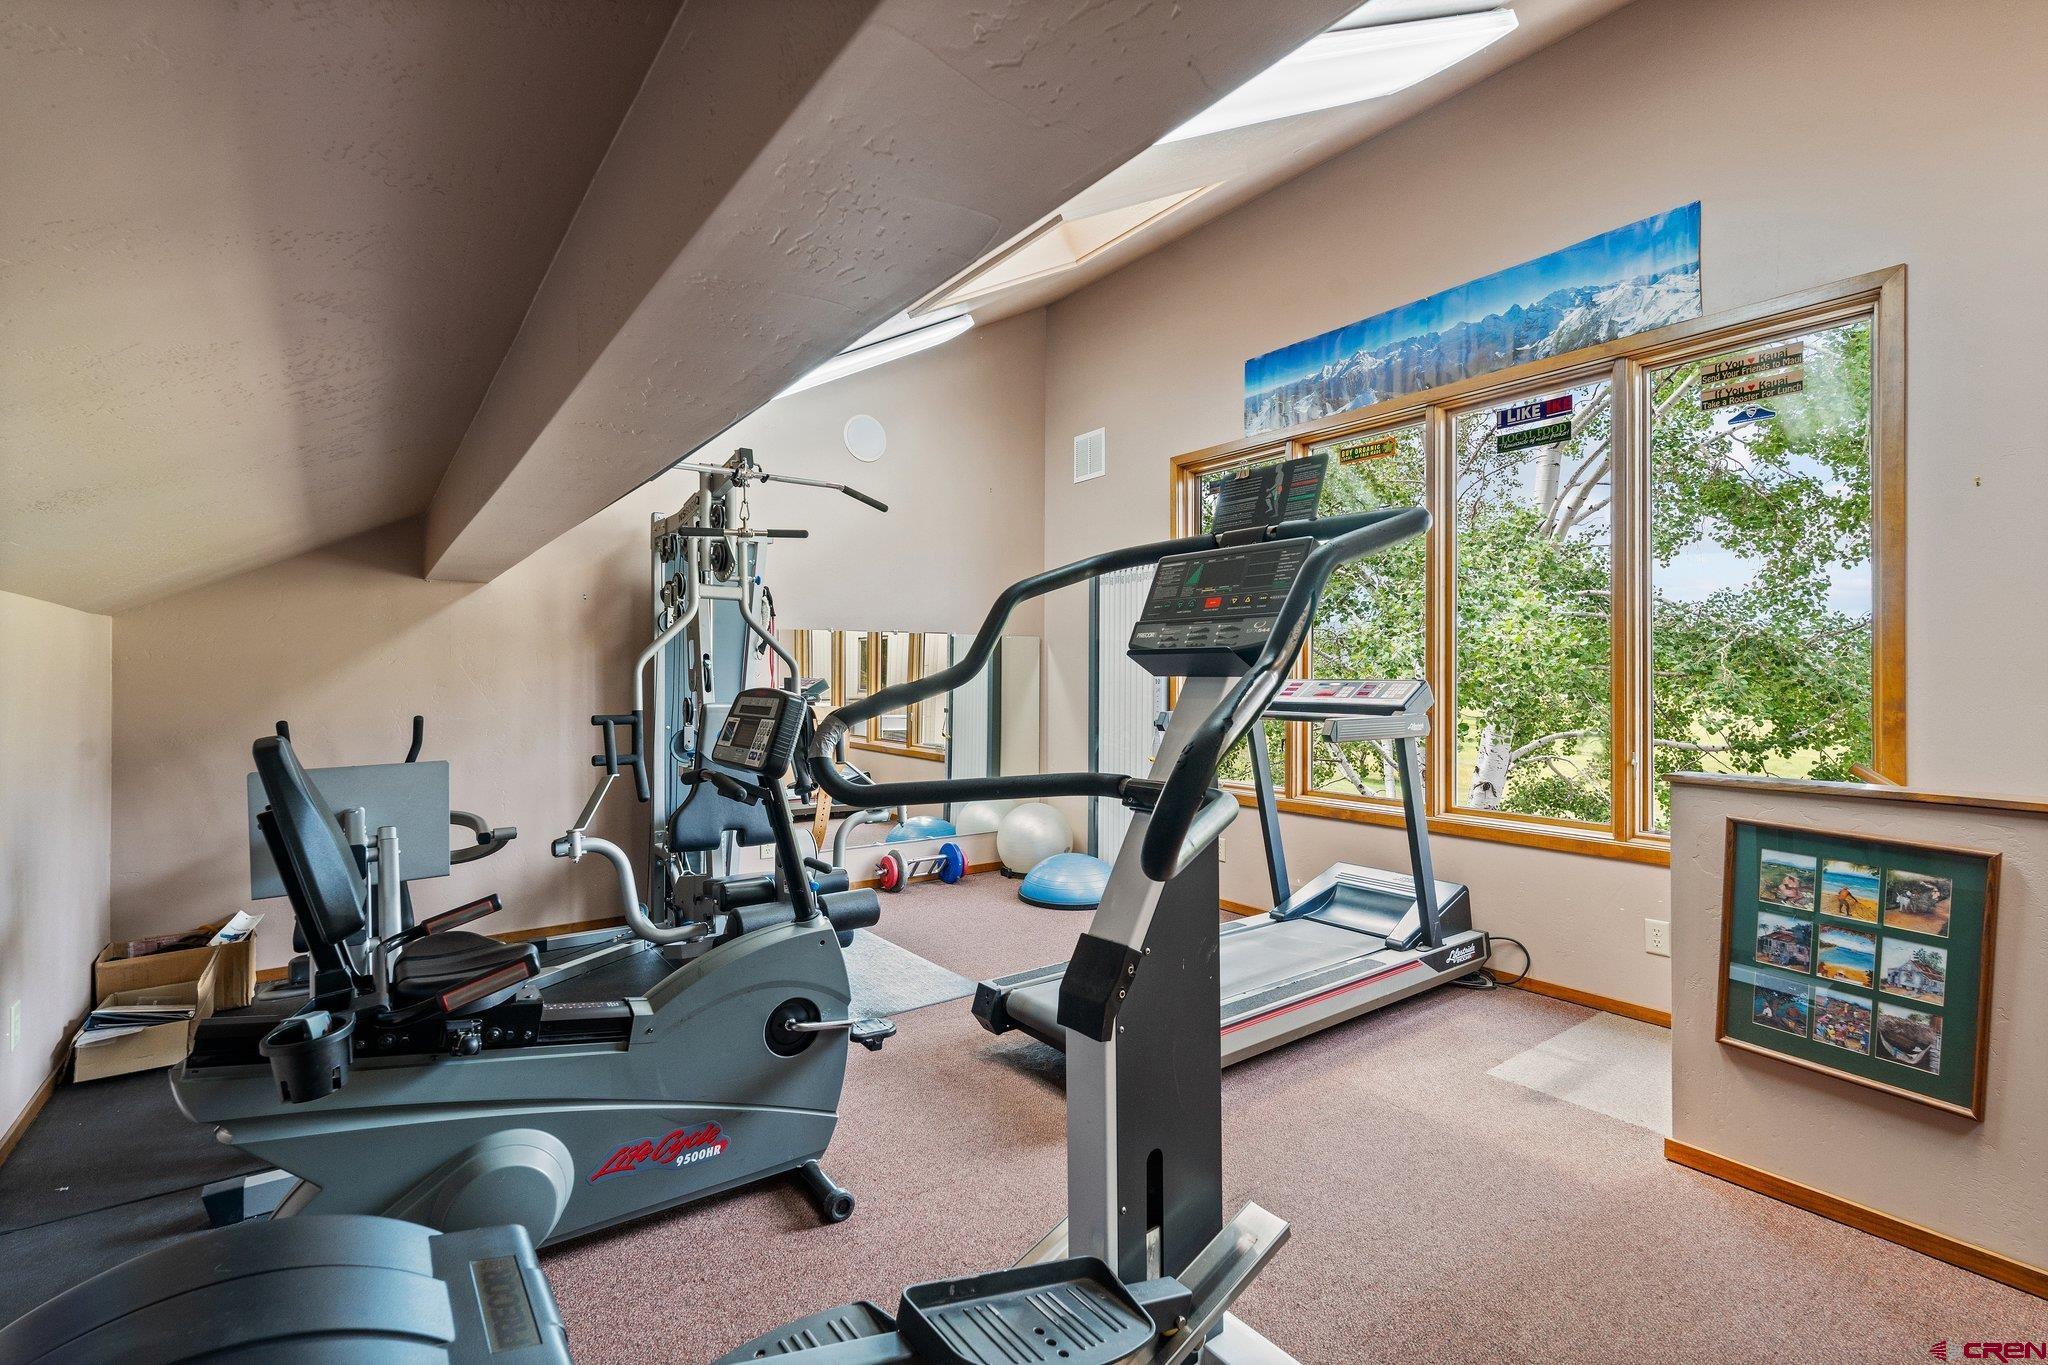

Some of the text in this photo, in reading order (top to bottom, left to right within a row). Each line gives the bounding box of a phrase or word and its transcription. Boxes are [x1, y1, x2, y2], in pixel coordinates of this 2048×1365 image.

[1702, 354, 1802, 384] Send Your Friends to Maui
[1714, 349, 1788, 372] If You Kauai
[1703, 400, 1721, 410] Take
[1729, 392, 1760, 405] Rooster
[1761, 388, 1775, 397] For
[1777, 384, 1802, 395] Lunch
[1714, 377, 1788, 399] If You Kauai
[1507, 404, 1541, 423] LIKE
[1502, 423, 1567, 444] LOCAL FOOD
[1354, 444, 1381, 454] ORGANIC
[676, 1144, 722, 1167] 9500HR
